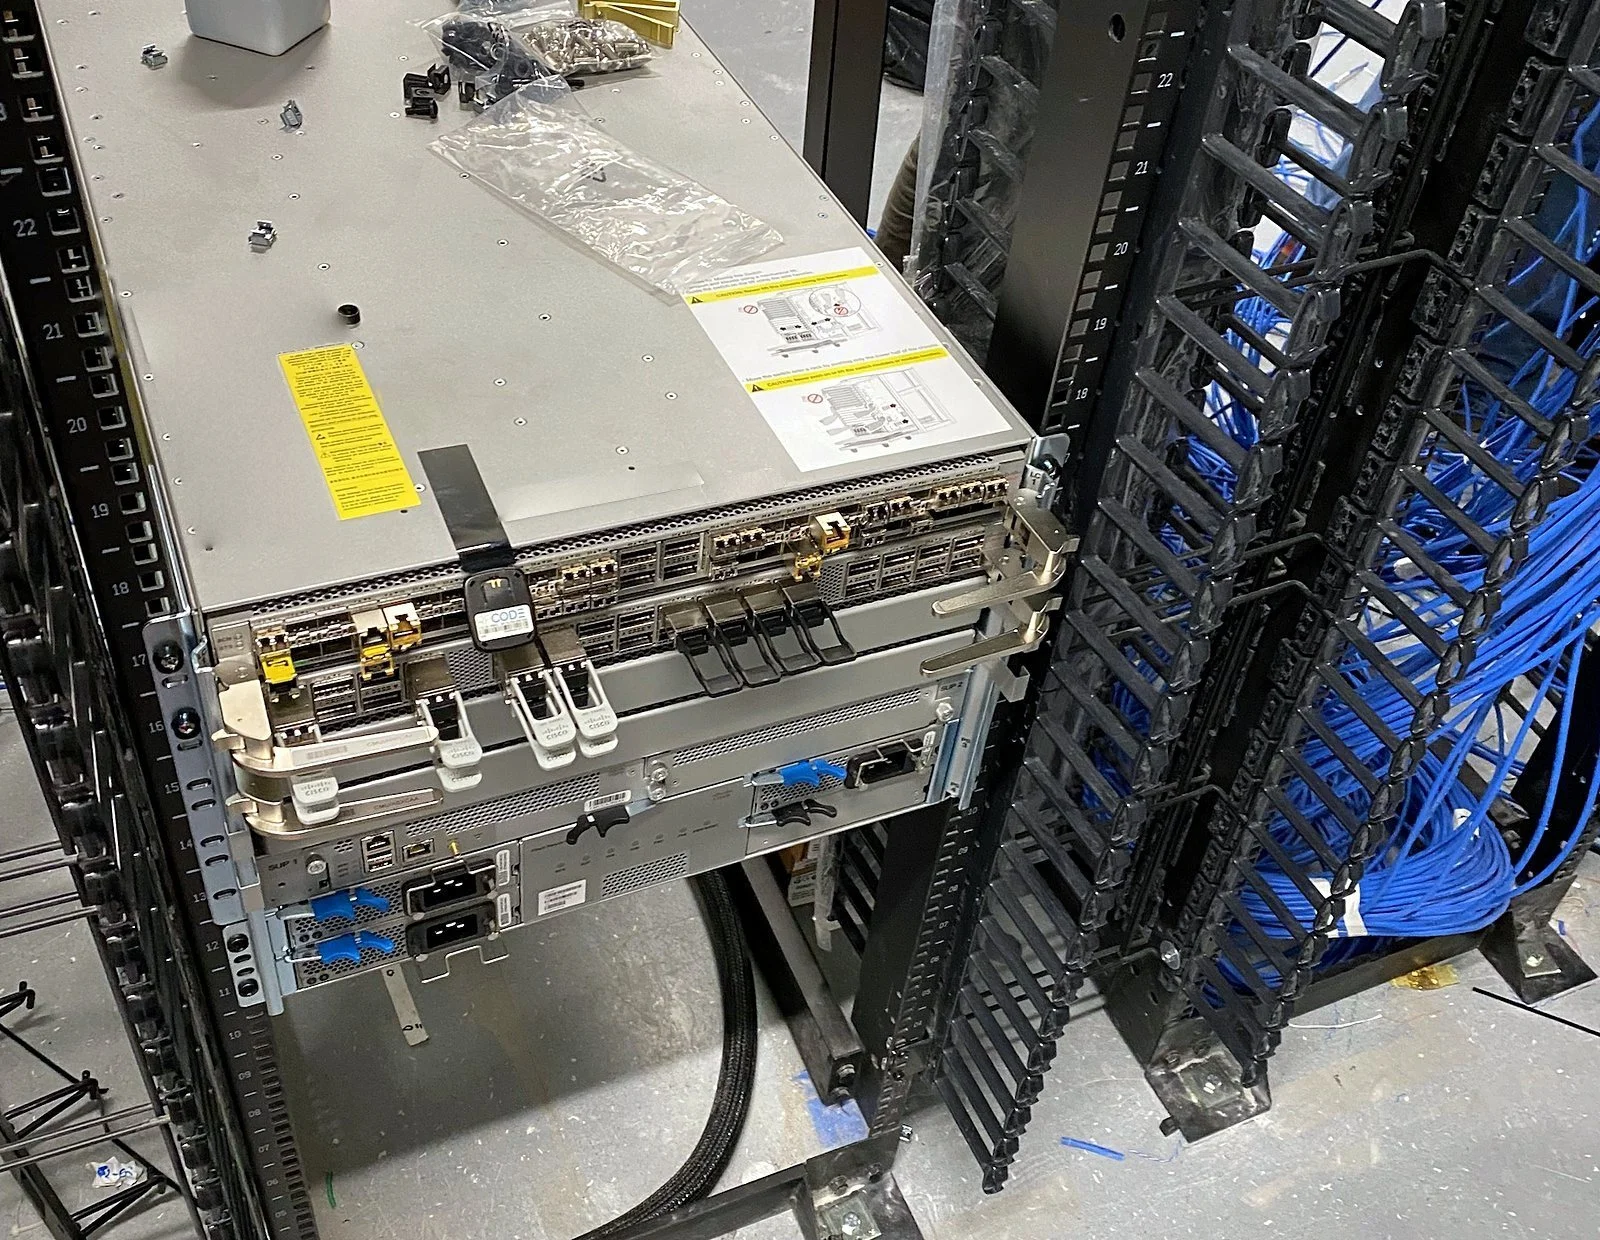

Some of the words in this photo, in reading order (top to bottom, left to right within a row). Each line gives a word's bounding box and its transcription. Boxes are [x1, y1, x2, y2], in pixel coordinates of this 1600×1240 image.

[1158, 72, 1174, 88] 22
[1134, 161, 1148, 175] 21
[13, 218, 37, 237] 22
[1113, 242, 1129, 255] 20
[42, 322, 65, 340] 21
[1094, 317, 1107, 331] 19
[1075, 387, 1089, 400] 18
[67, 417, 87, 434] 20
[91, 503, 110, 519] 19
[111, 582, 130, 596] 18
[491, 608, 525, 623] CODE
[132, 653, 146, 668] 17
[149, 720, 164, 734] 16
[164, 782, 180, 794] 15
[180, 839, 193, 851] 14
[268, 860, 290, 871] SUP
[205, 940, 220, 952] 12
[219, 987, 231, 998] 11
[229, 1030, 241, 1040] 10
